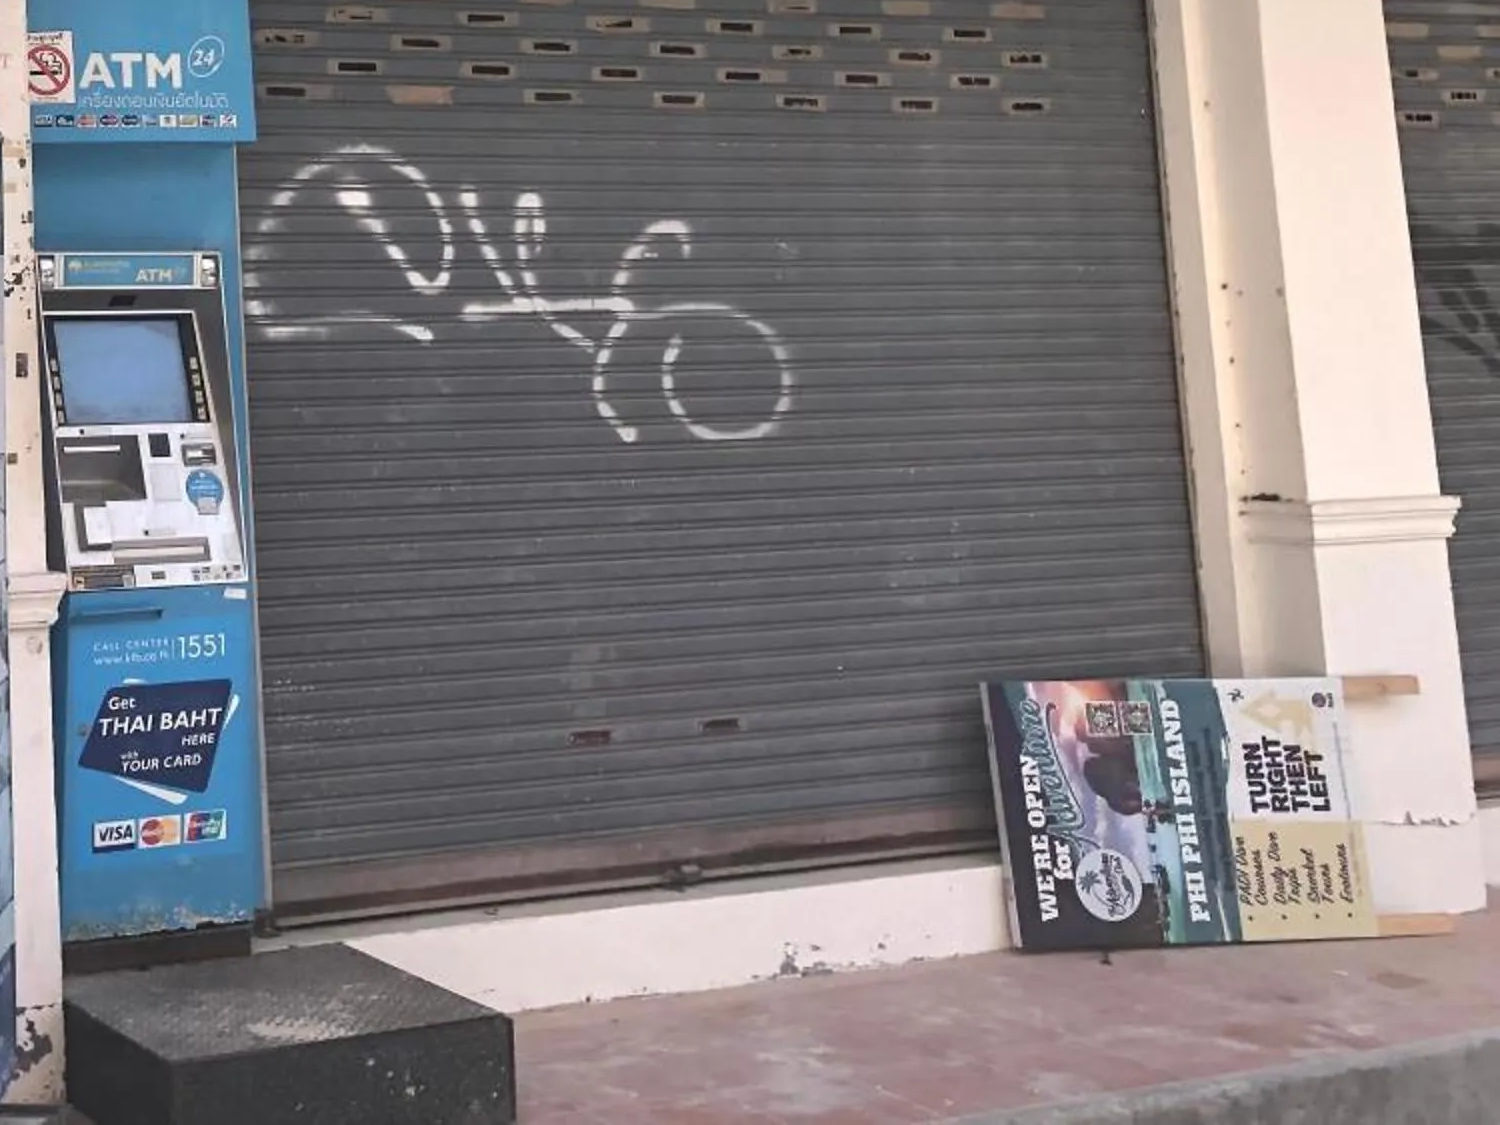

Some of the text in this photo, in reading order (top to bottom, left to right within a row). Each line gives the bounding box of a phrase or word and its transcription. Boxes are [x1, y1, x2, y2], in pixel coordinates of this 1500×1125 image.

[79, 49, 216, 89] ATM 24
[135, 268, 173, 283] ATM
[177, 633, 226, 660] 1551
[99, 707, 223, 737] THAI BAHT
[108, 696, 137, 711] Get
[181, 732, 216, 747] HERE
[1160, 698, 1191, 805] ISLAND
[121, 753, 203, 774] YOUR CARD
[1243, 742, 1271, 813] TURN
[1262, 735, 1291, 813] RIGHT
[1283, 744, 1311, 813] THEN
[1304, 750, 1331, 813] LEFT
[1019, 698, 1085, 882] for Adventure
[1019, 753, 1047, 828] OPEN
[98, 824, 134, 842] VISA
[1177, 812, 1204, 863] PHI
[1185, 869, 1211, 923] PHI
[1252, 849, 1269, 906] Courses
[1271, 866, 1289, 906] Daily
[1288, 868, 1302, 905] Trips
[1300, 847, 1320, 904] Snorkel
[1320, 862, 1335, 905] Tours
